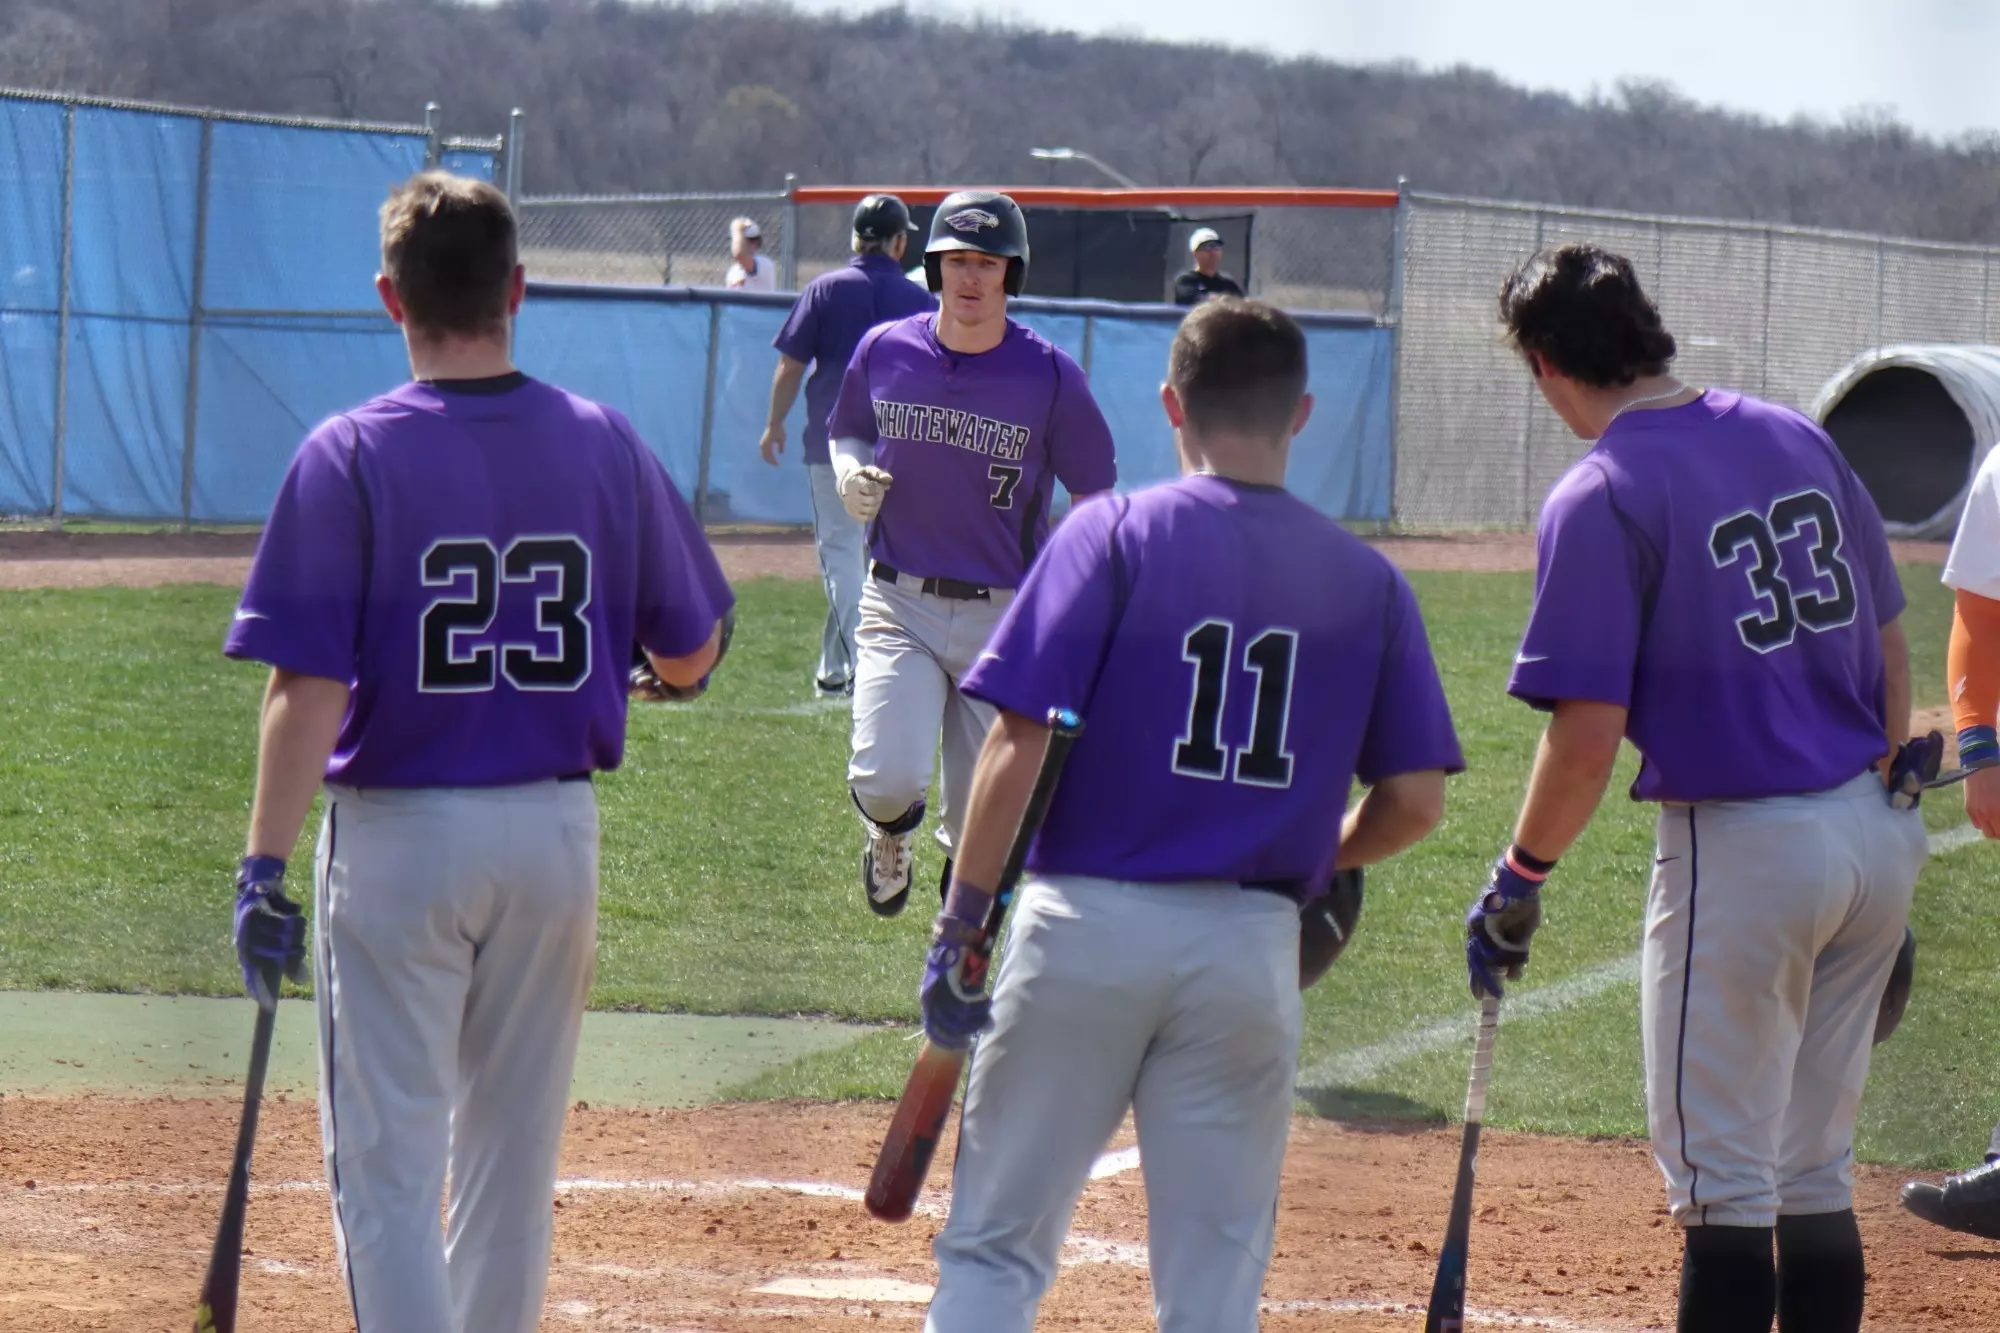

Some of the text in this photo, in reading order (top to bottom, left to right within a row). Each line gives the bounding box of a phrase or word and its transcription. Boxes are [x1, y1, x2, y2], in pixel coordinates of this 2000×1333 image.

[873, 399, 1031, 461] WHITEWATER
[988, 464, 1023, 509] 7
[418, 533, 592, 693] 23
[1708, 488, 1858, 655] 33
[1171, 617, 1299, 789] 11
